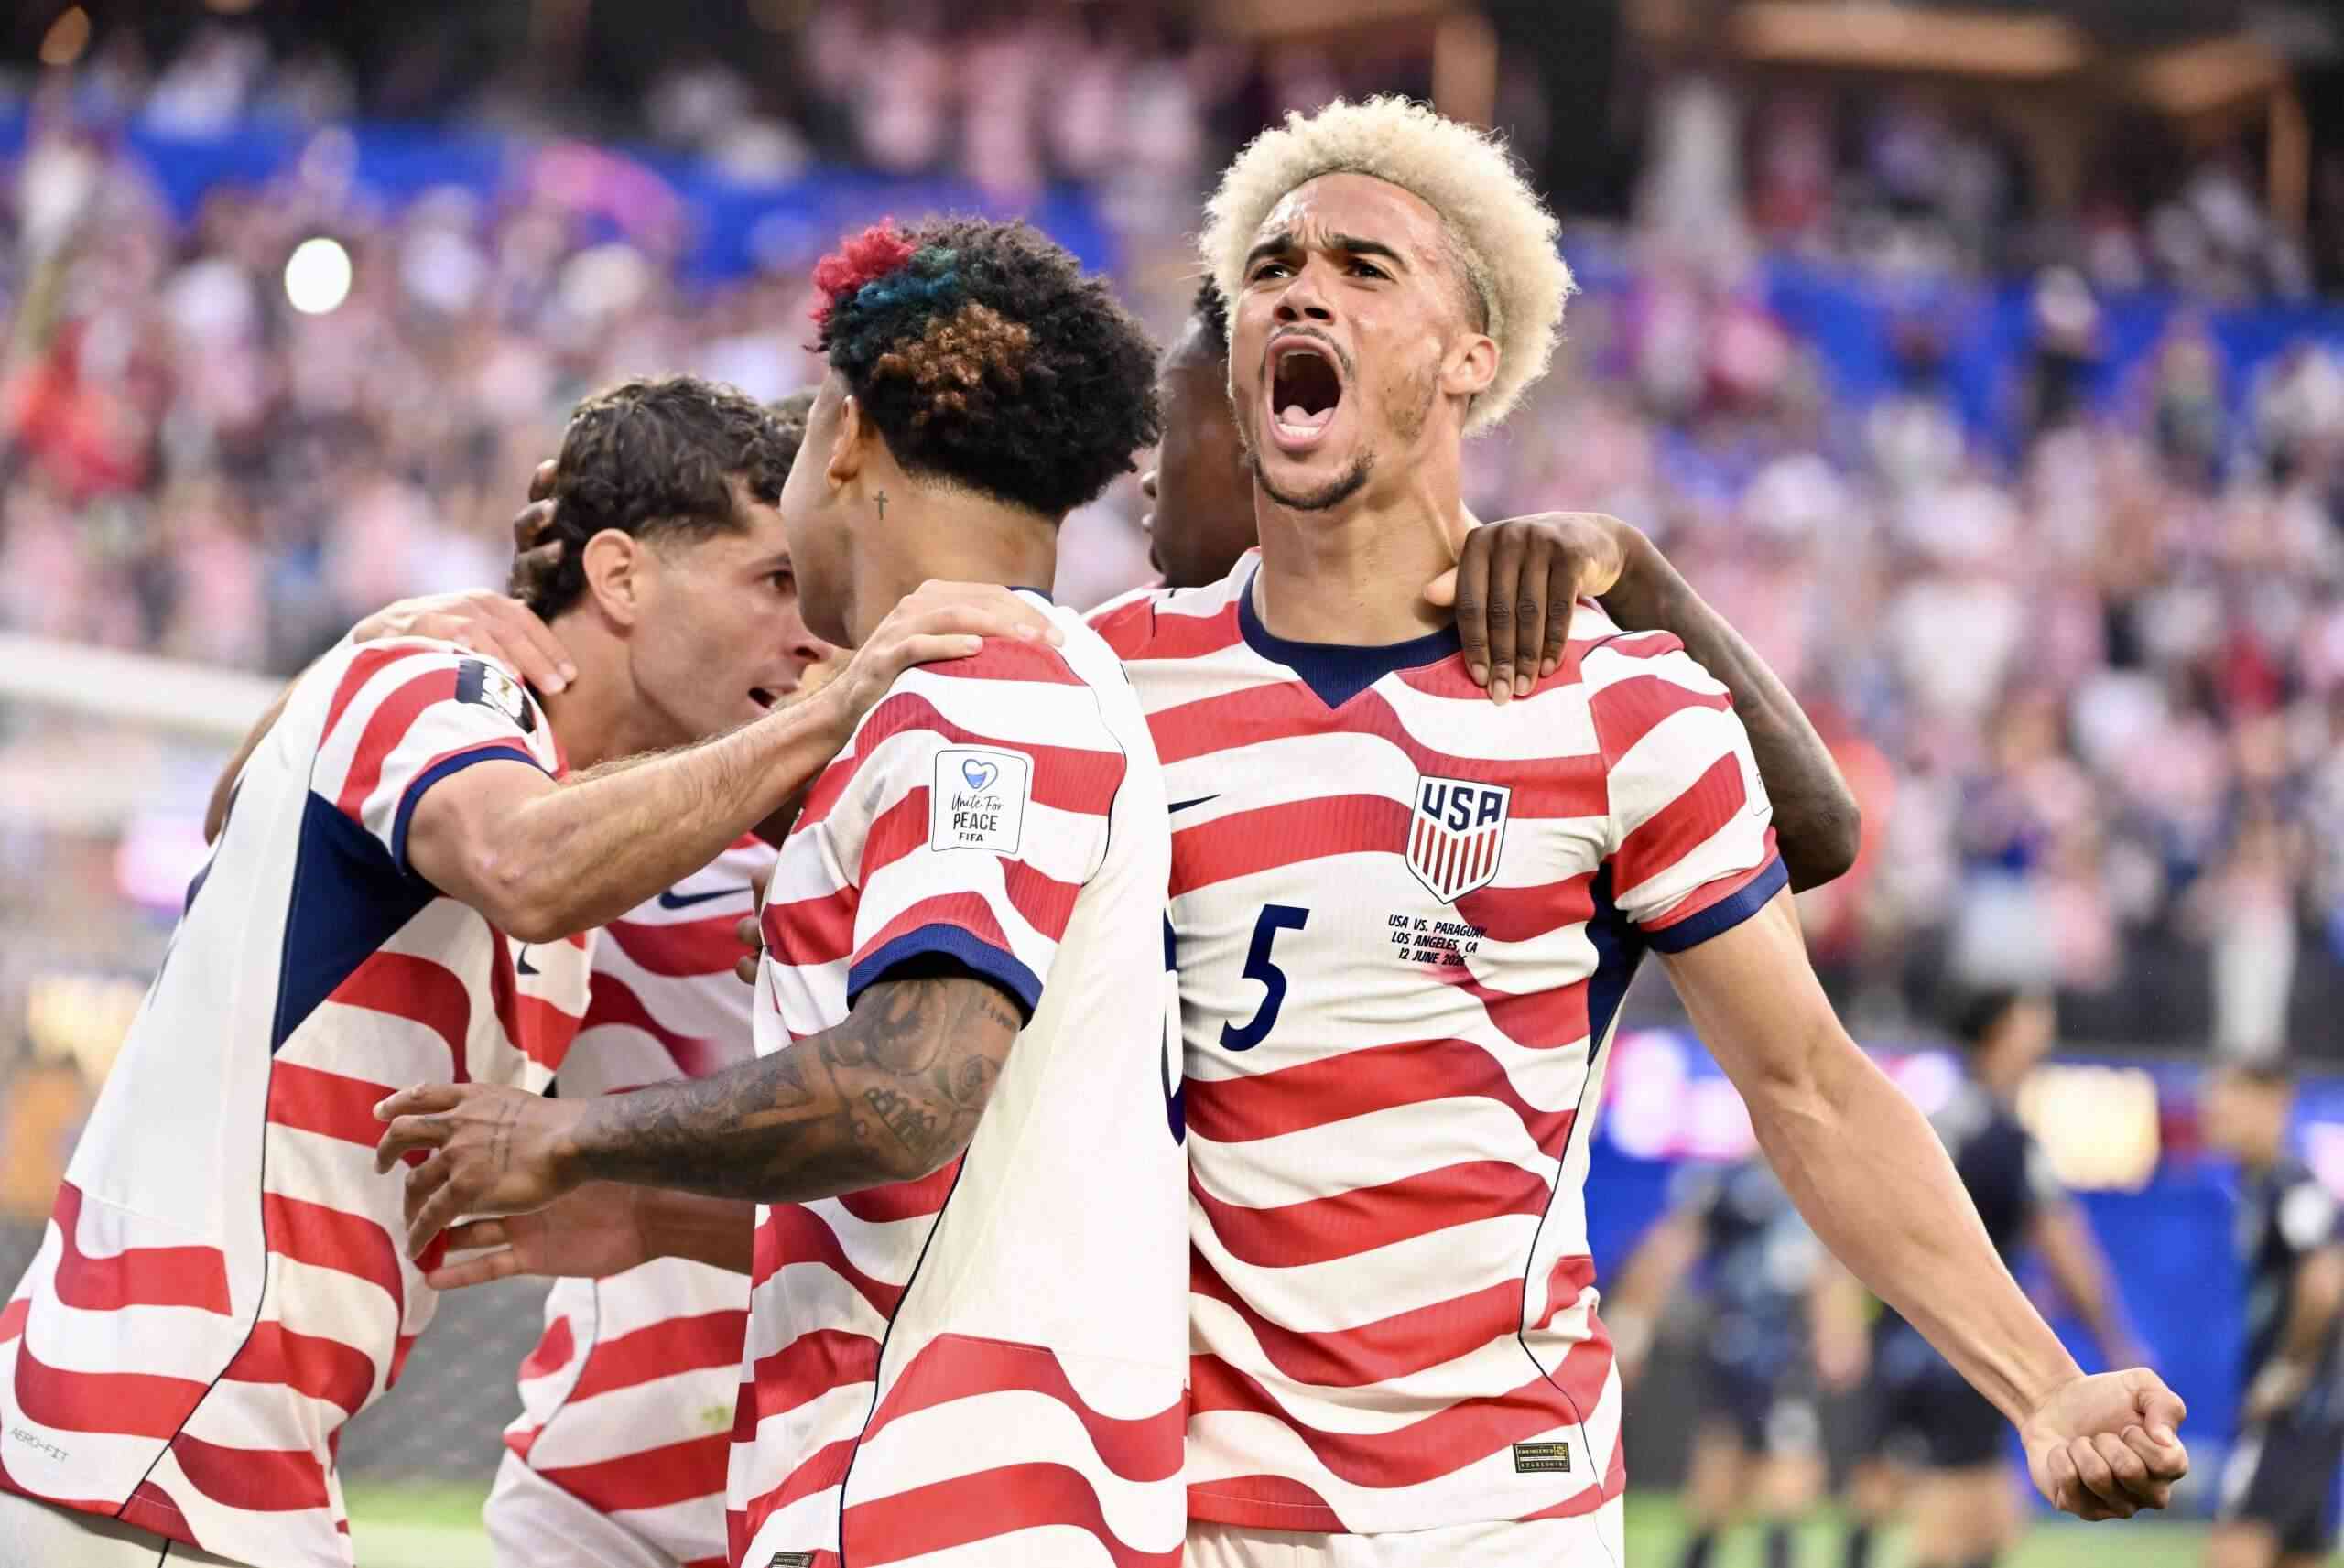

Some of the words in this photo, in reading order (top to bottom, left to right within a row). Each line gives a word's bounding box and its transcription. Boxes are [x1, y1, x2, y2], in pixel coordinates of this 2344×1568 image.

[951, 791, 983, 812] Unite
[984, 795, 1003, 811] For
[1422, 783, 1503, 832] USA
[953, 812, 998, 831] PEACE
[959, 832, 984, 842] FIFA
[1388, 914, 1409, 929] USA
[1413, 918, 1428, 932] VS.
[1433, 921, 1488, 939] PARAGUAY
[1391, 931, 1411, 945] LOS
[1414, 935, 1460, 953] ANGELES,
[1465, 941, 1478, 954] CA
[1398, 947, 1410, 960] 12
[1412, 950, 1440, 964] JUNE
[1219, 903, 1310, 1052] 5
